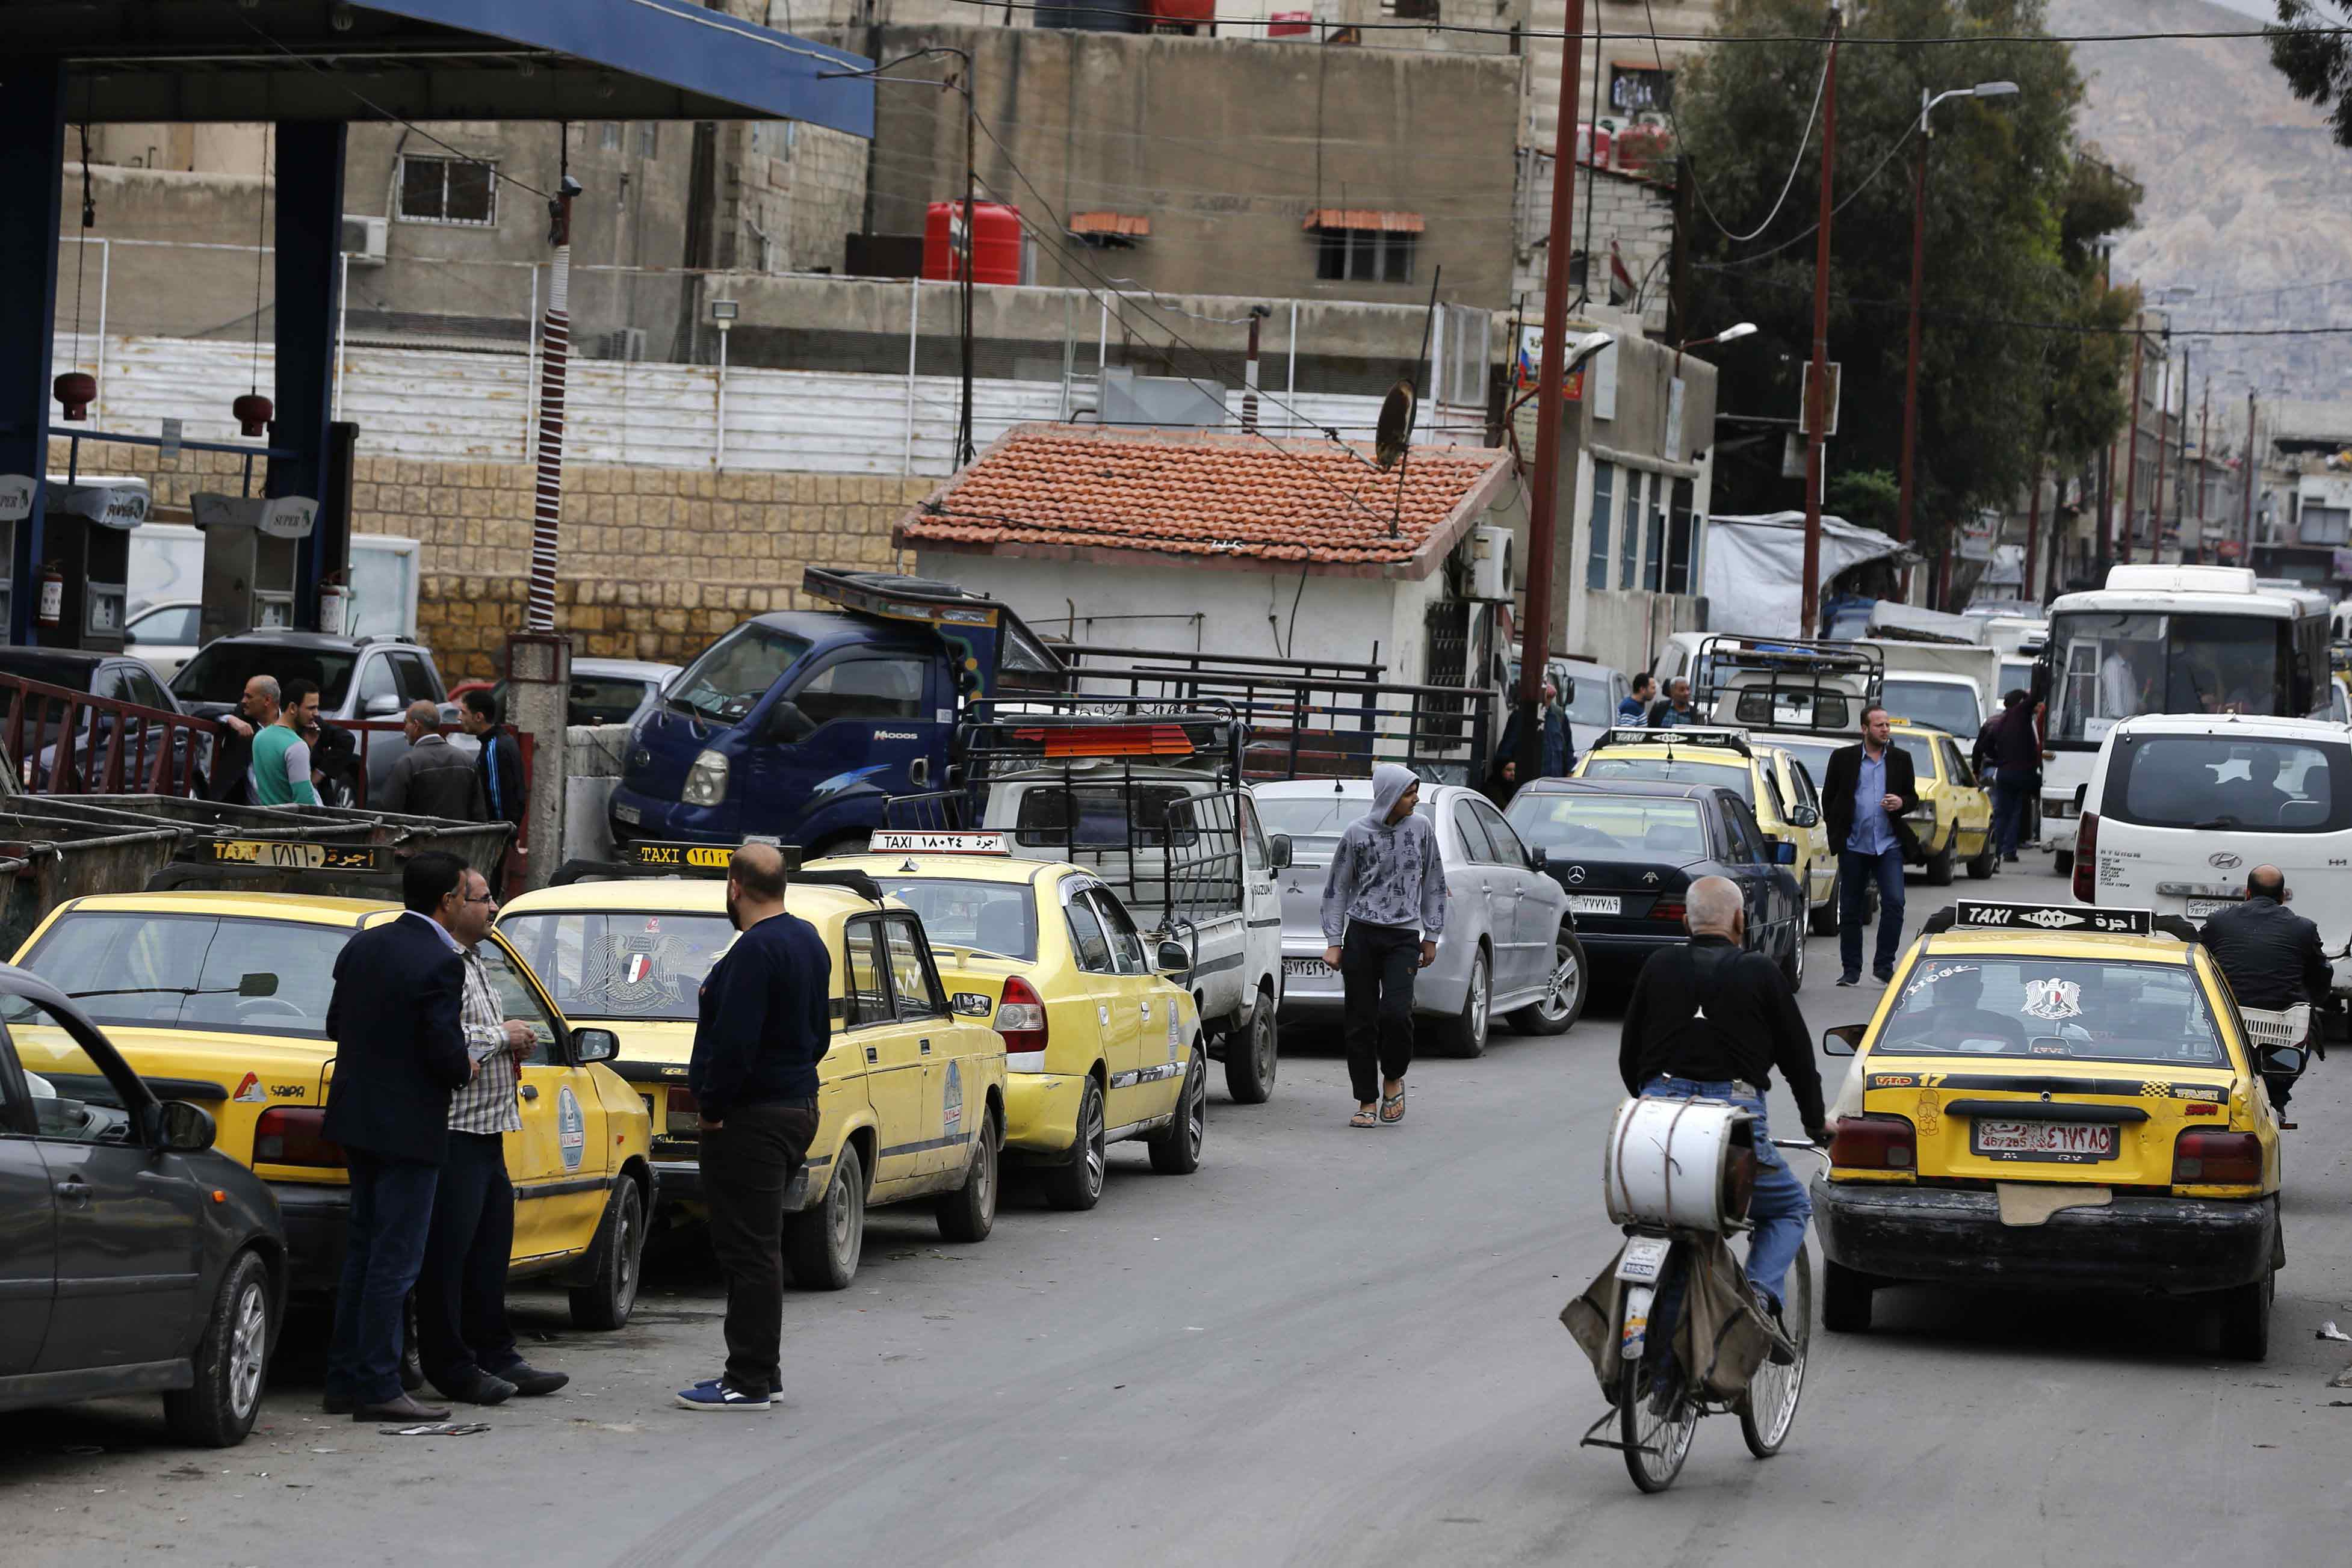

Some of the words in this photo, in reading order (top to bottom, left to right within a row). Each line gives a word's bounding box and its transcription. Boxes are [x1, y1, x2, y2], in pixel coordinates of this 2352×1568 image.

[274, 514, 300, 528] SUPER
[1616, 732, 1647, 742] TAXI
[885, 836, 912, 849] TAXI
[922, 836, 963, 848] ١٨٠٢٤
[641, 847, 679, 863] TAXI
[1583, 898, 1618, 911] ٧٧٧٧٨٩
[1969, 907, 2013, 924] TAXI
[2094, 913, 2137, 931] أجرة
[1293, 960, 1331, 975] ٧٢٤٢٩٠
[1875, 1076, 1912, 1086] VIP
[1918, 1073, 1948, 1087] 17
[2174, 1088, 2219, 1101] TAXI
[1983, 1136, 2027, 1147] 467285
[2047, 1126, 2109, 1150] ٤٦٧٢٨٥
